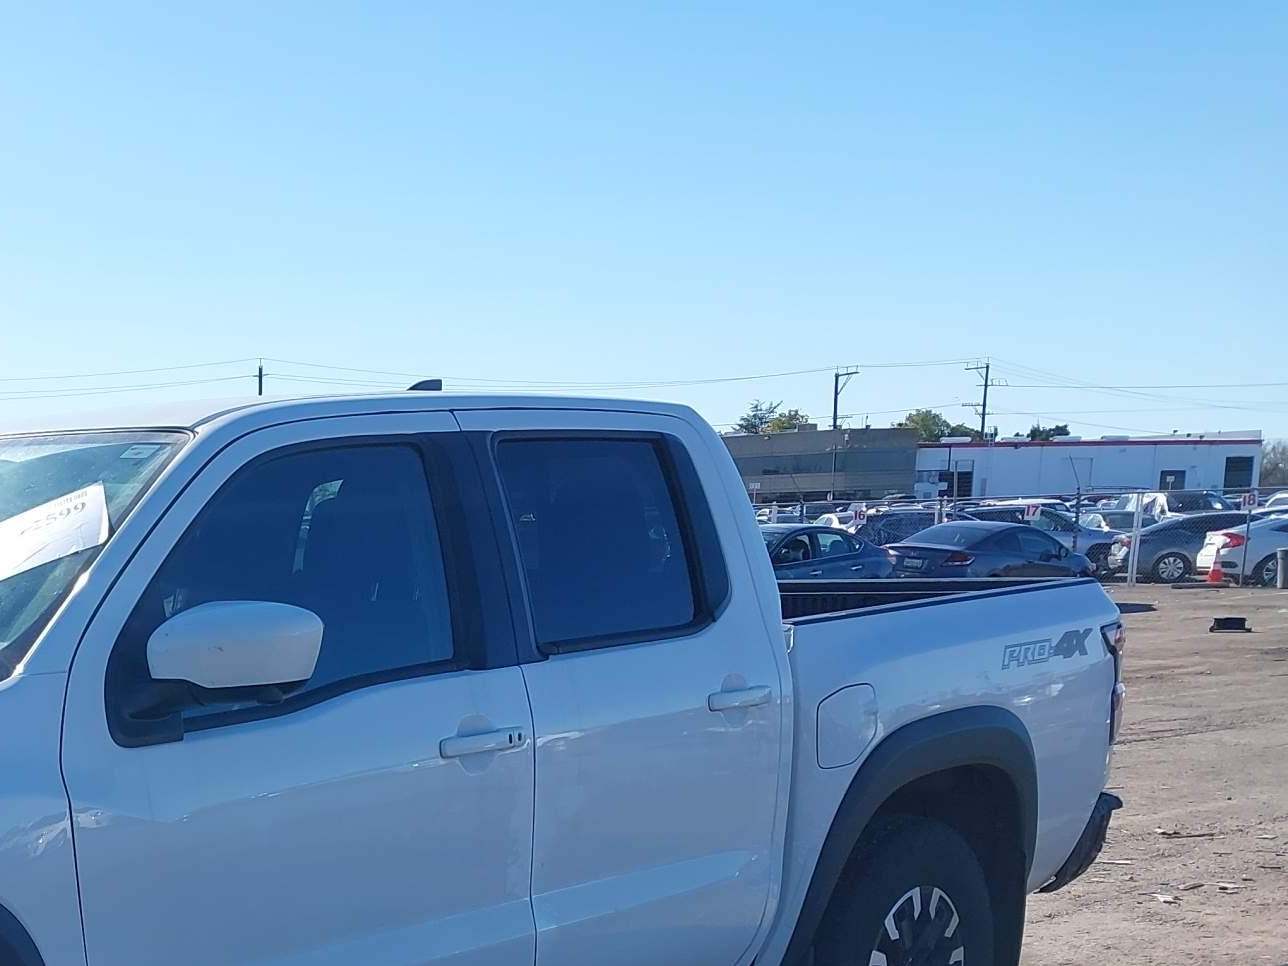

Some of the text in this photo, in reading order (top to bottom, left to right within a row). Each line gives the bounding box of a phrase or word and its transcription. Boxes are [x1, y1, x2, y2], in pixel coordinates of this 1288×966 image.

[1242, 493, 1257, 507] 18
[854, 510, 866, 521] 16
[1025, 504, 1041, 517] 17
[1001, 628, 1094, 670] PRO-4X
